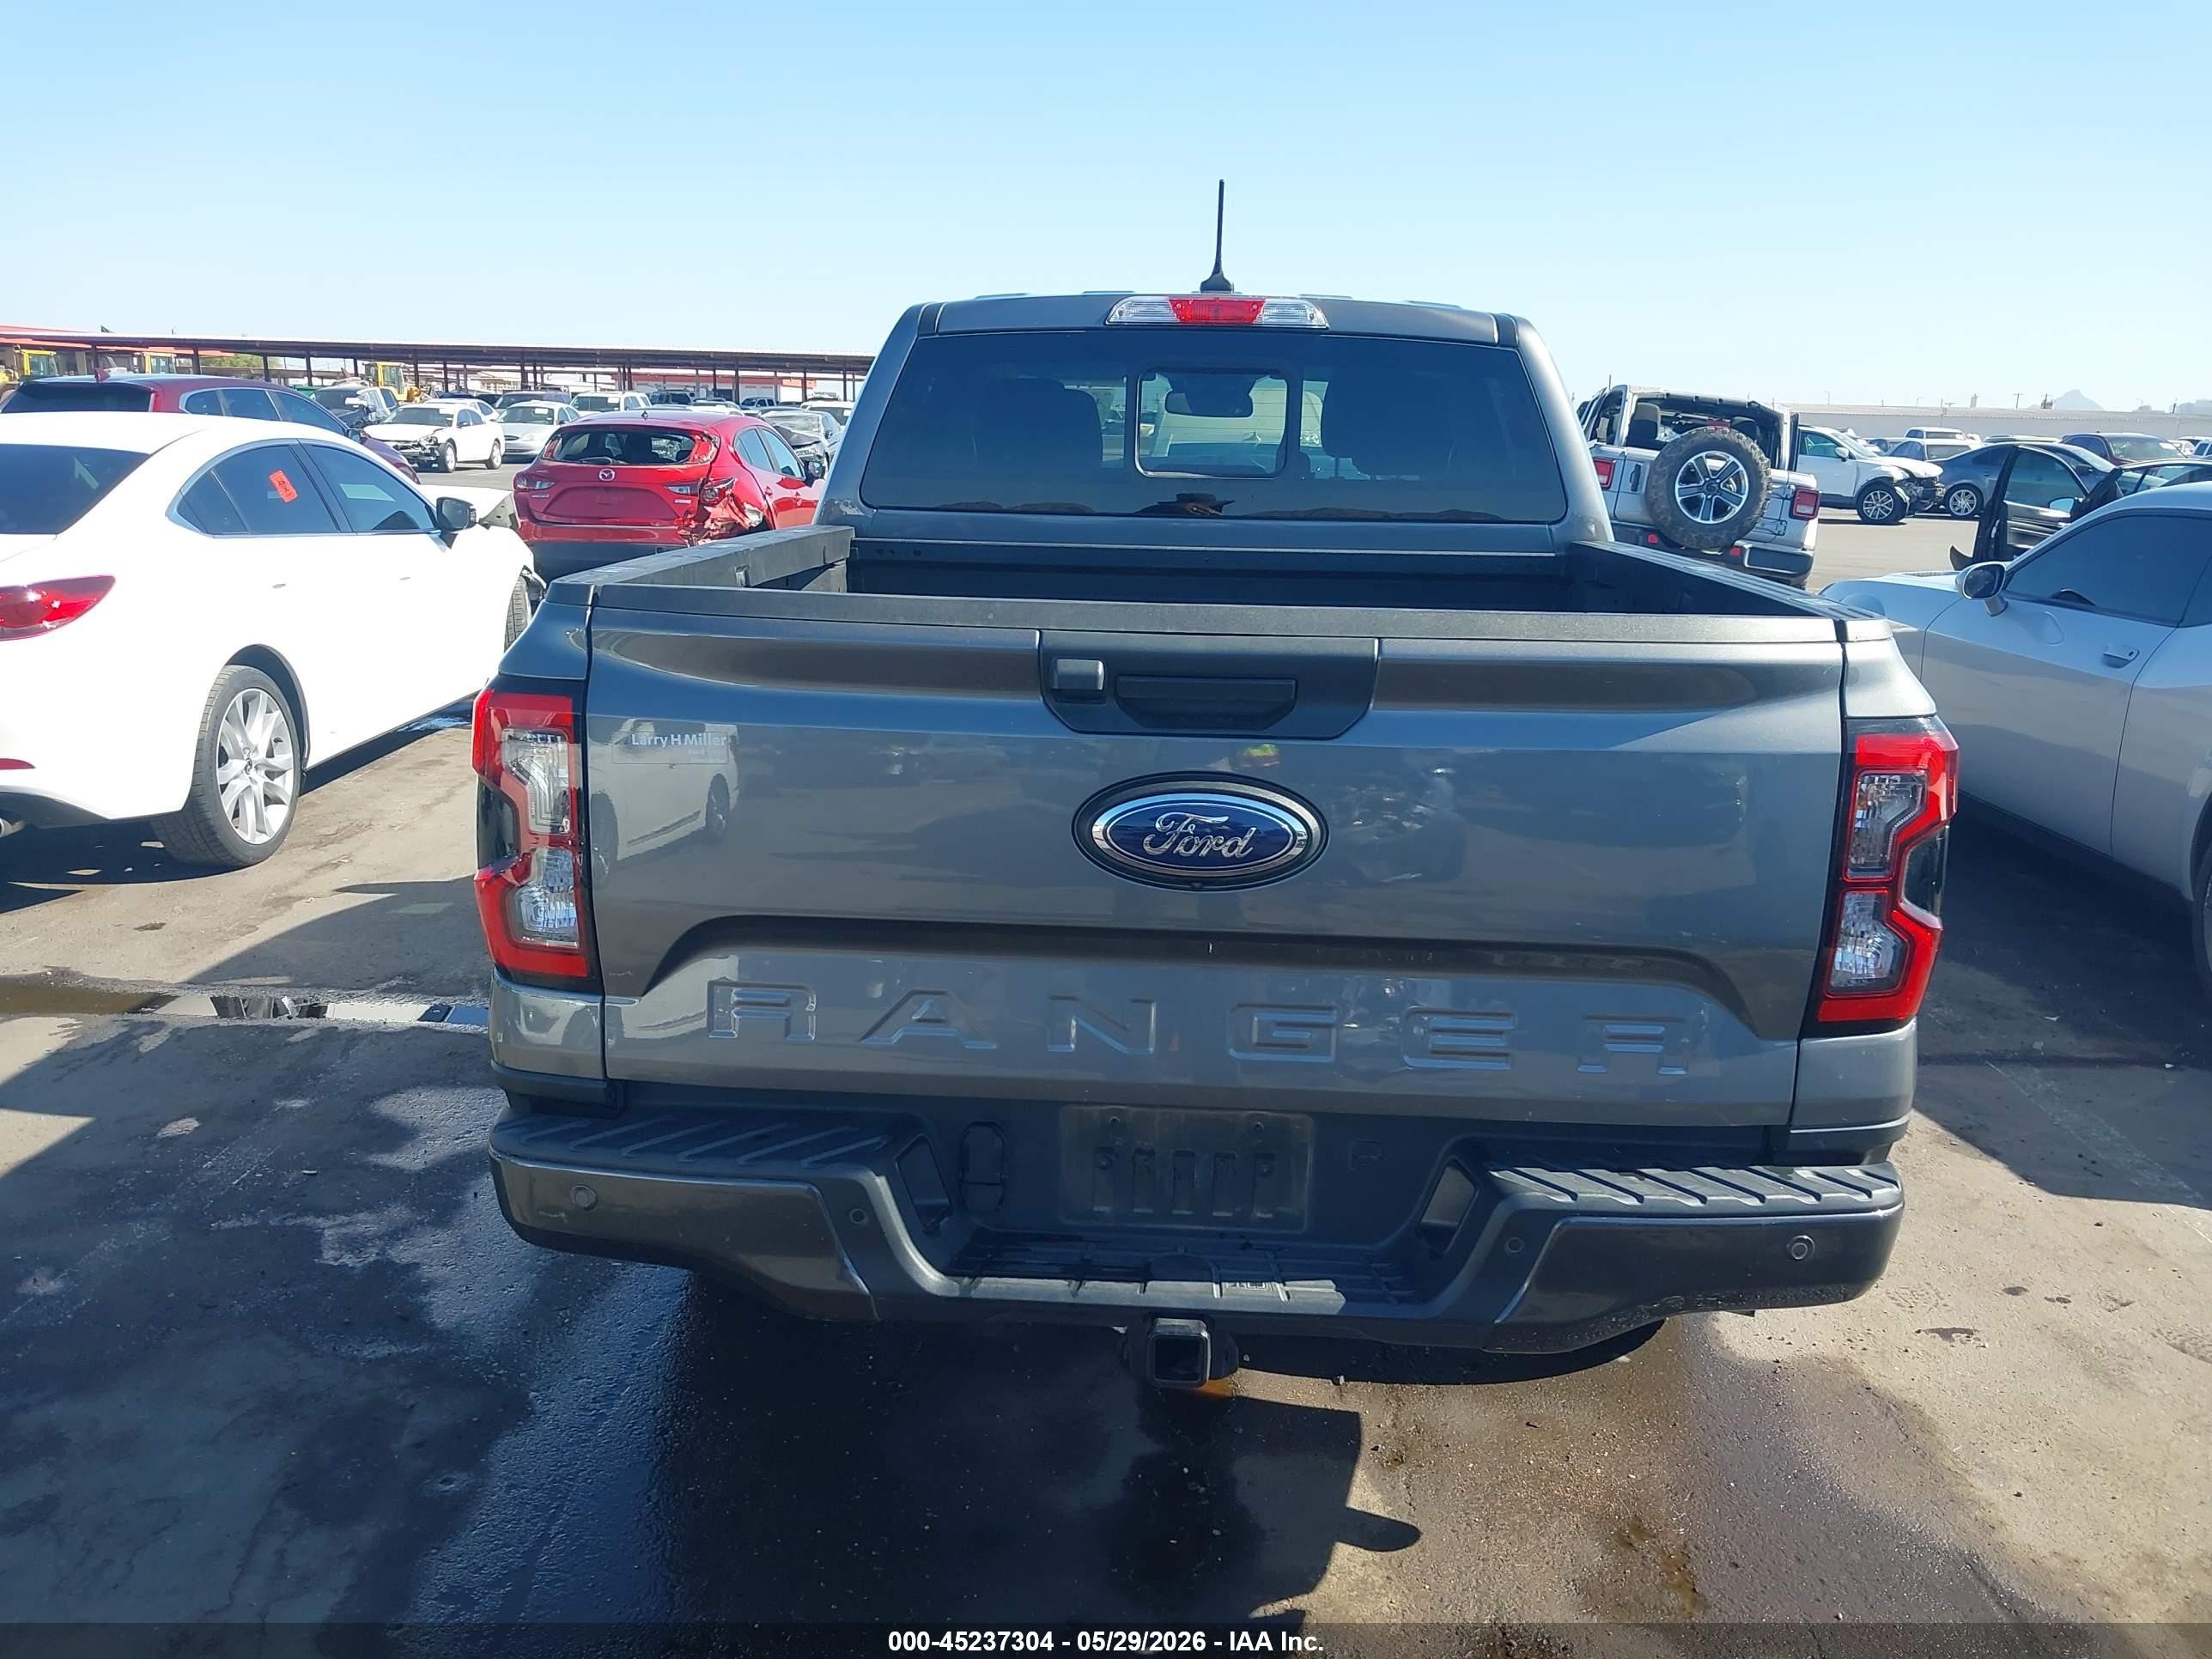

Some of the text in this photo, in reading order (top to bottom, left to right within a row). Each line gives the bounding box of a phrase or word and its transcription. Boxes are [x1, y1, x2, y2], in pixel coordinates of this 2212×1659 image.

[632, 732, 727, 748] Larry H Miller
[1143, 811, 1257, 858] Ford
[706, 978, 1688, 1075] RANGER
